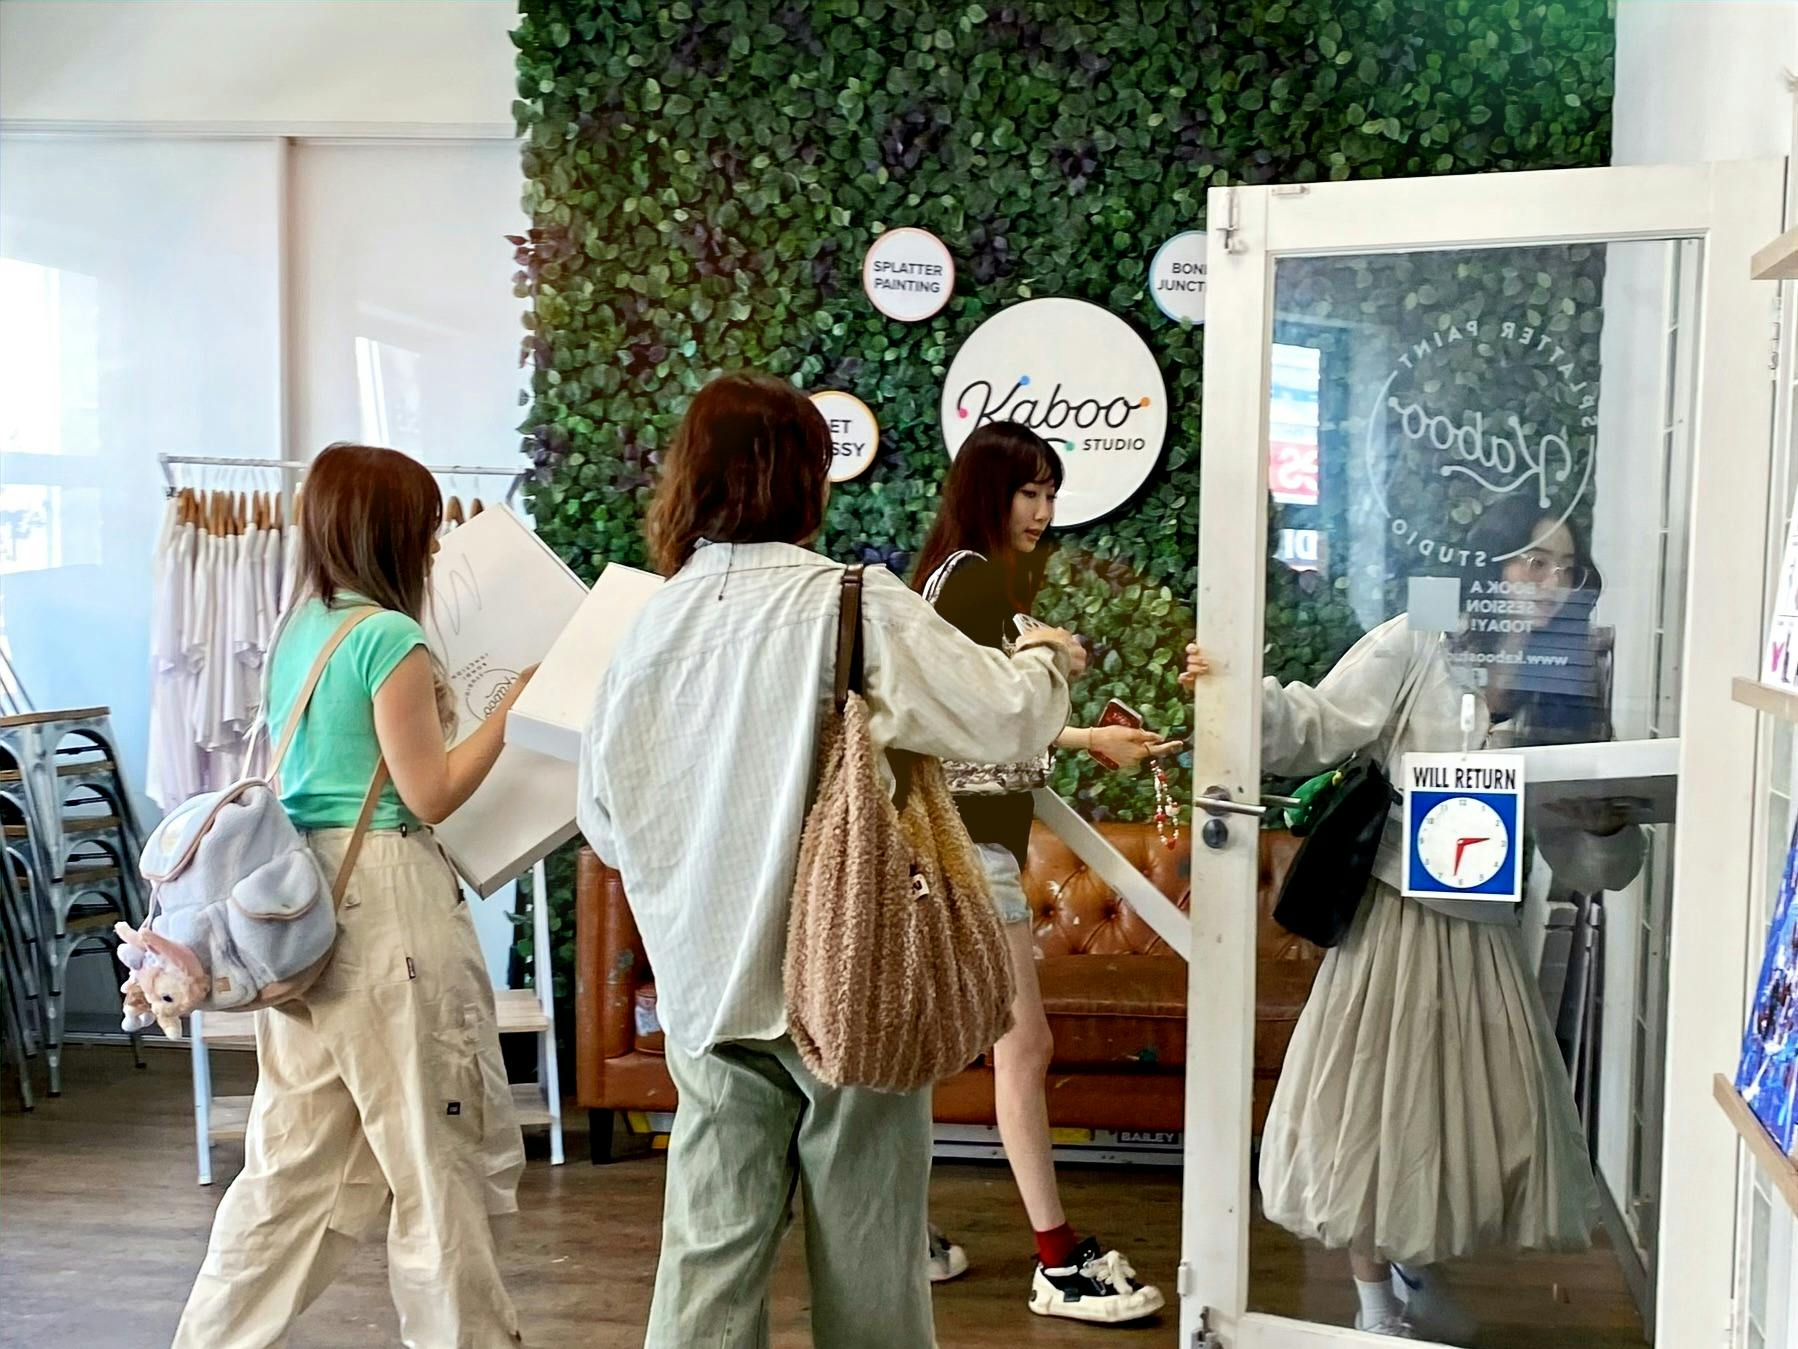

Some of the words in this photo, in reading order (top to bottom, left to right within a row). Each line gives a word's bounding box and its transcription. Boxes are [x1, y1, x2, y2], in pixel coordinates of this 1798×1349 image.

[873, 260, 943, 276] SPLATTER
[1172, 262, 1207, 276] BON
[874, 278, 940, 293] PAINTING
[1157, 280, 1206, 292] JUNCT
[957, 374, 1150, 429] Kaboo
[829, 418, 852, 434] ET
[831, 441, 866, 457] SSY
[1082, 438, 1145, 451] STUDIO
[1413, 767, 1449, 788] WILL
[1455, 768, 1516, 789] RETURN
